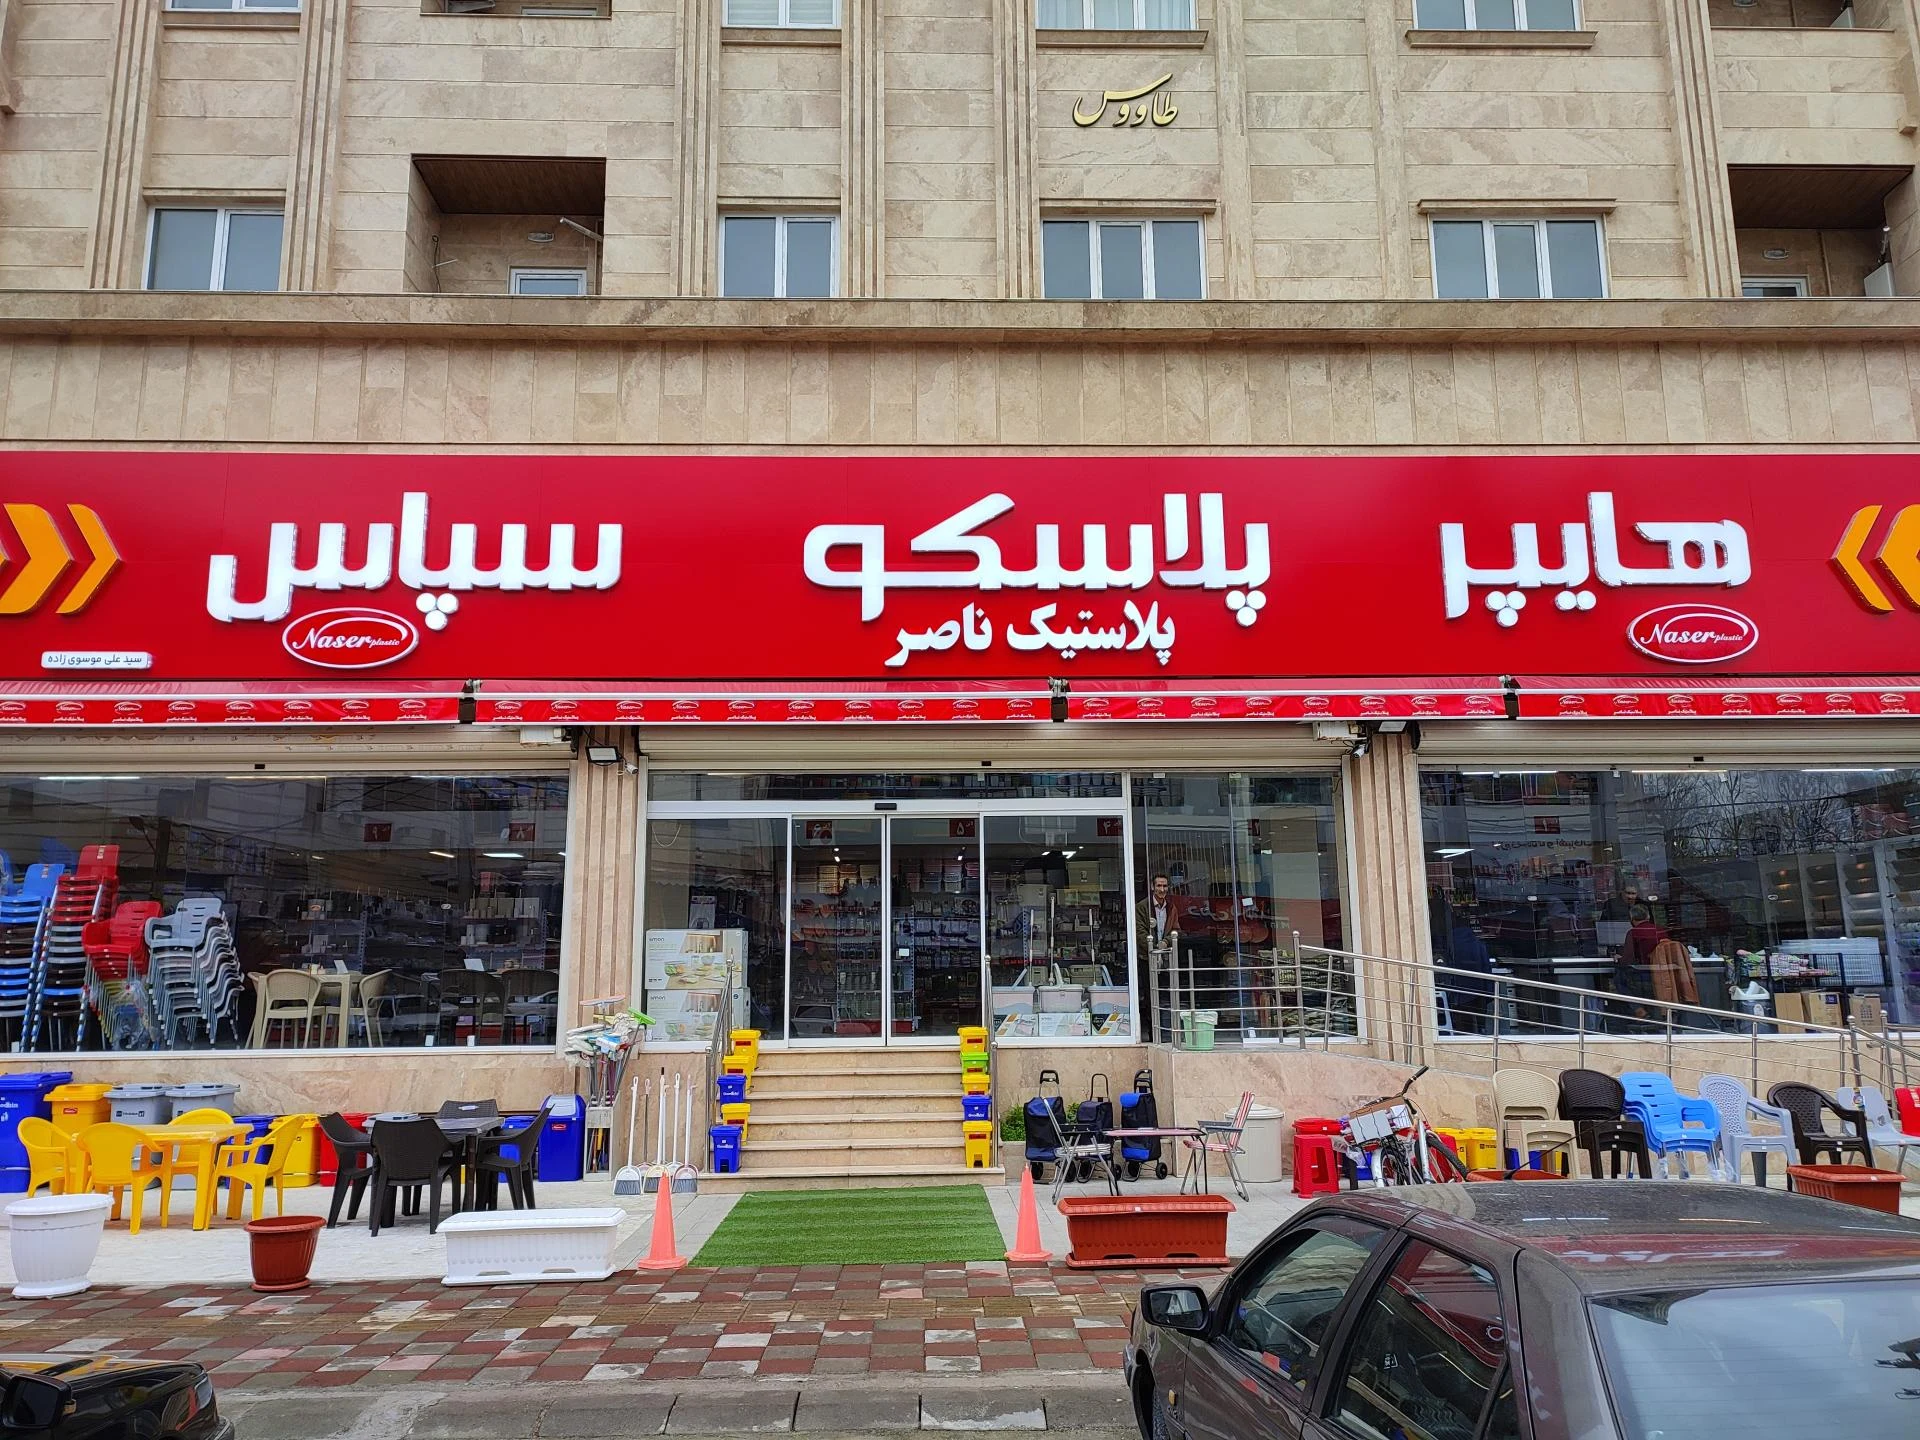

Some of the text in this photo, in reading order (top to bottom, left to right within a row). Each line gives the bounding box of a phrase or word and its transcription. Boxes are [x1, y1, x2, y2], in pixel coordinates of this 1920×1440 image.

[1072, 72, 1178, 128] طاووس
[206, 491, 1751, 631] هایپر پلاسکو سپاس
[292, 627, 400, 650] Naser plastic
[884, 599, 1176, 667] پلاستیک ناصر
[1640, 623, 1743, 645] Naser plastic
[47, 653, 142, 666] سید علی موسوی زاده
